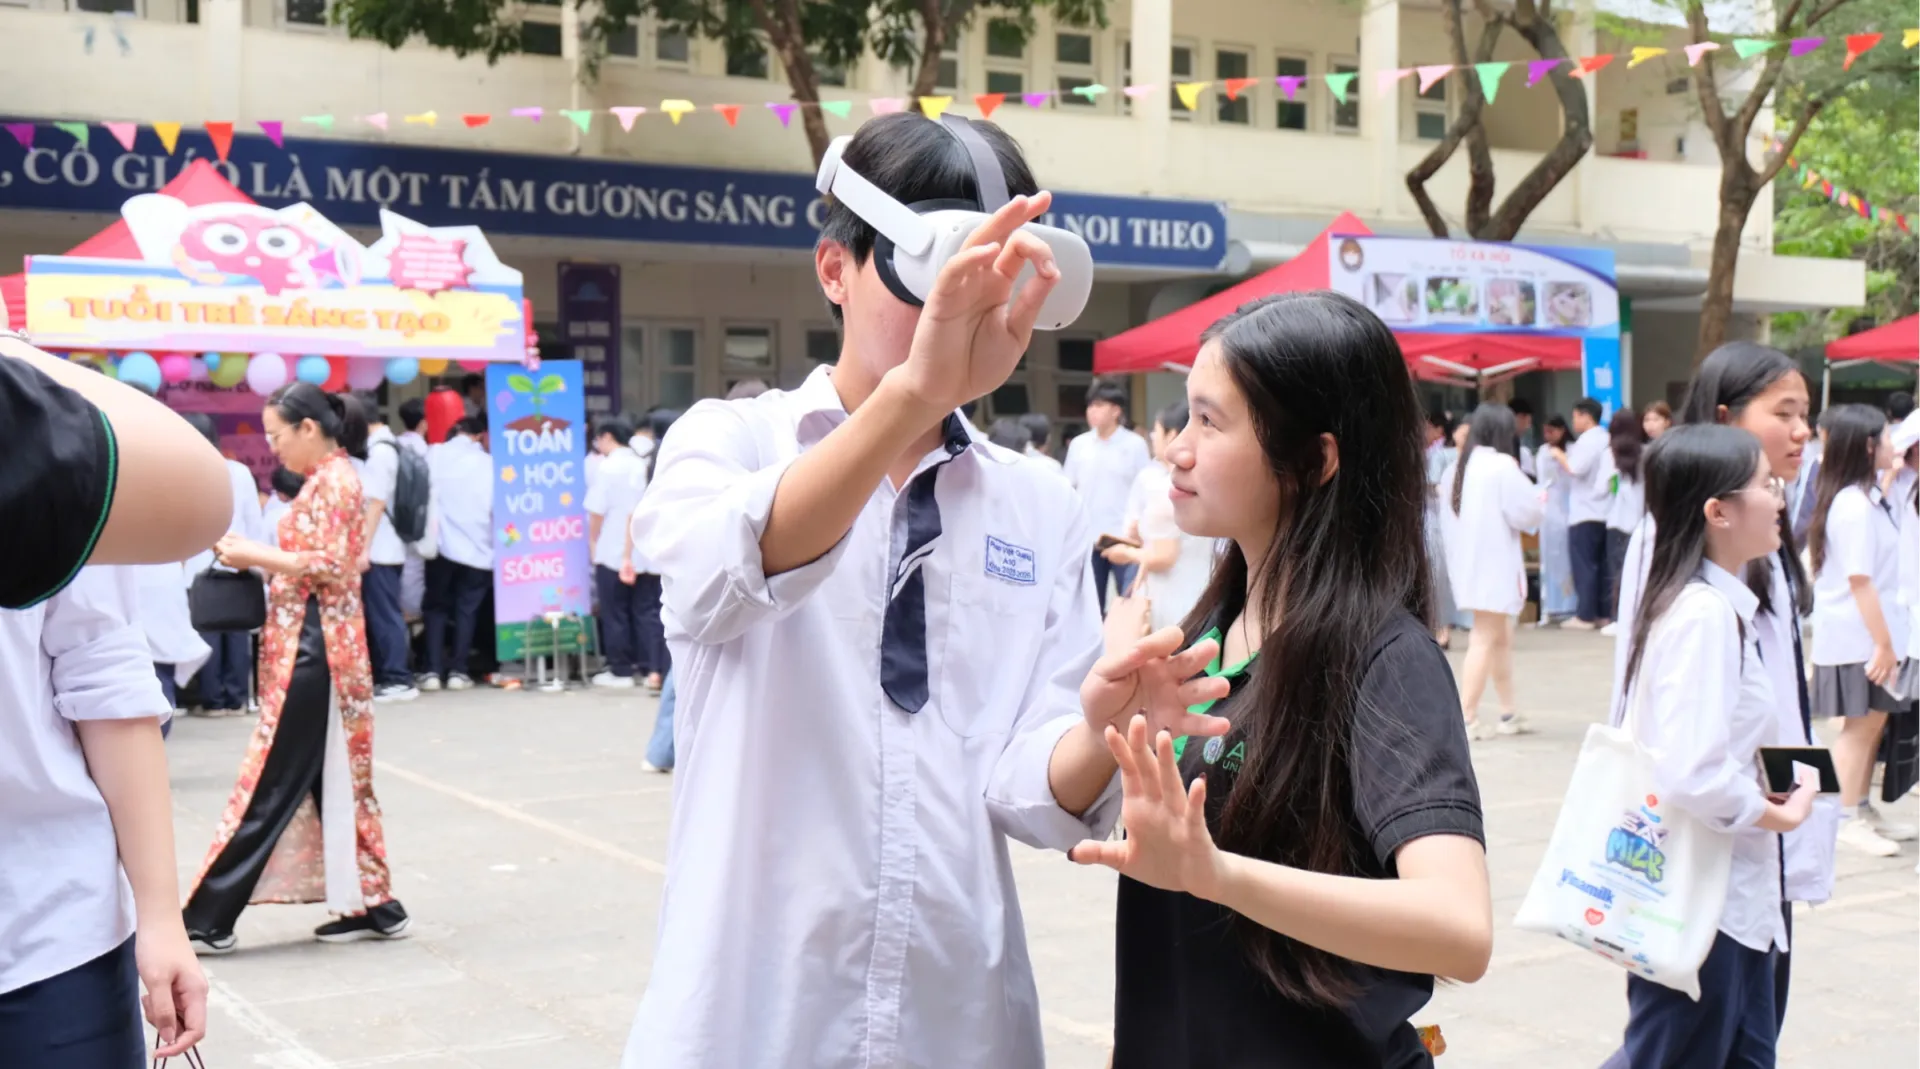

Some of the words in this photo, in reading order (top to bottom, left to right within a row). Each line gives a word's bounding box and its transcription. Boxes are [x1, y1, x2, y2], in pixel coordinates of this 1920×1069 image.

[23, 139, 99, 187] CÔ
[251, 154, 313, 200] LÀ
[326, 164, 429, 211] MỘT
[441, 168, 536, 213] TẤM
[544, 178, 688, 222] GƯƠNG
[695, 183, 795, 227] SÁNG
[1126, 216, 1214, 250] THEO
[65, 284, 173, 322] TUỔI
[180, 297, 257, 326] TRẺ
[260, 297, 369, 329] SÁNG
[372, 307, 452, 338] TẠO
[502, 420, 573, 456] TOÁN
[523, 461, 575, 488] HỌC
[505, 488, 543, 514] VỚI
[528, 518, 583, 543] CUỘC
